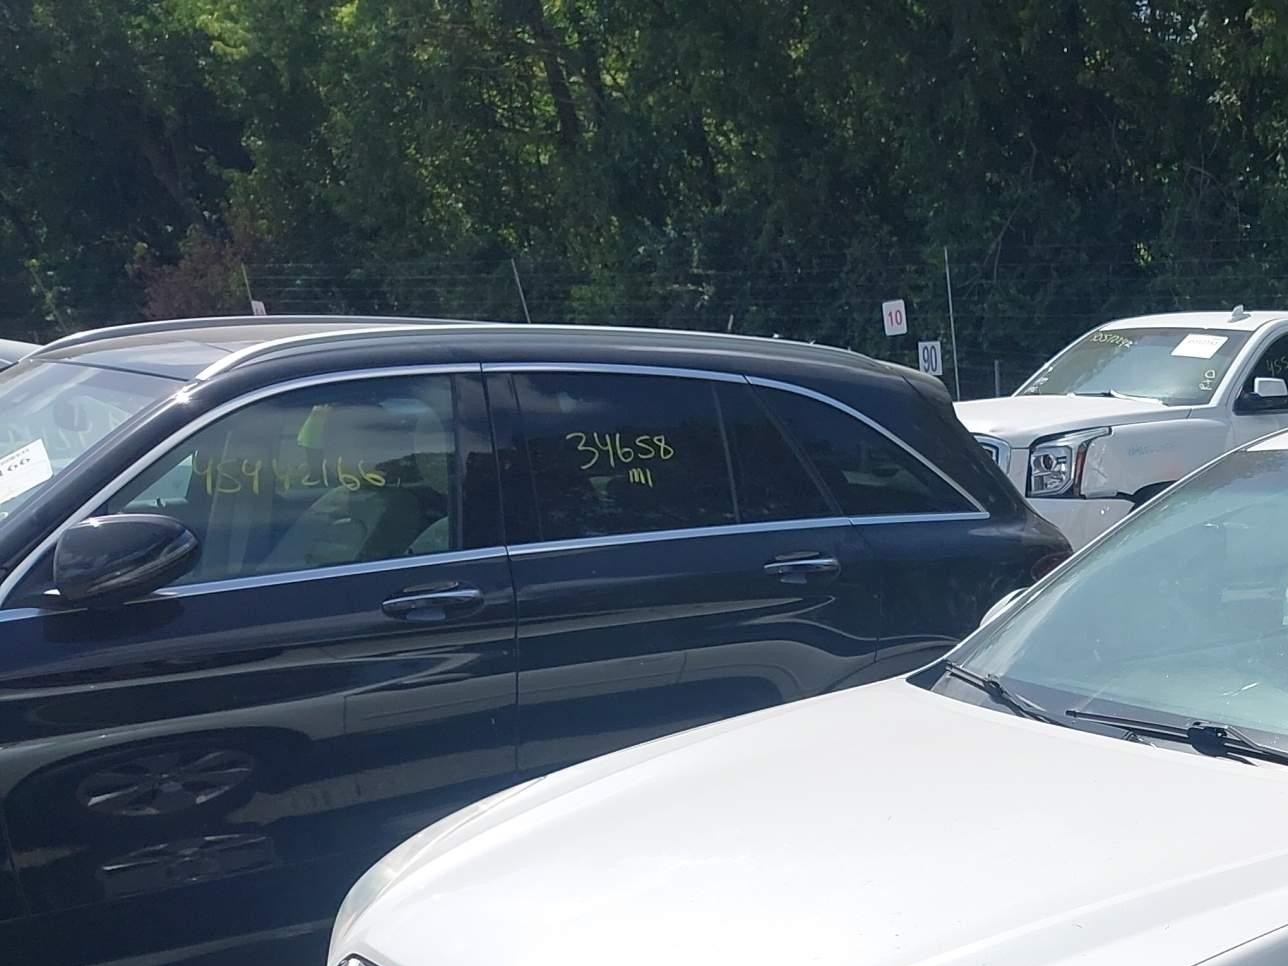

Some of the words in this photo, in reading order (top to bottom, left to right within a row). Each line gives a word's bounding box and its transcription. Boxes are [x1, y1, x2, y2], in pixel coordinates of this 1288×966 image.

[887, 309, 903, 327] 10
[922, 345, 938, 373] 90
[565, 431, 675, 470] 34658
